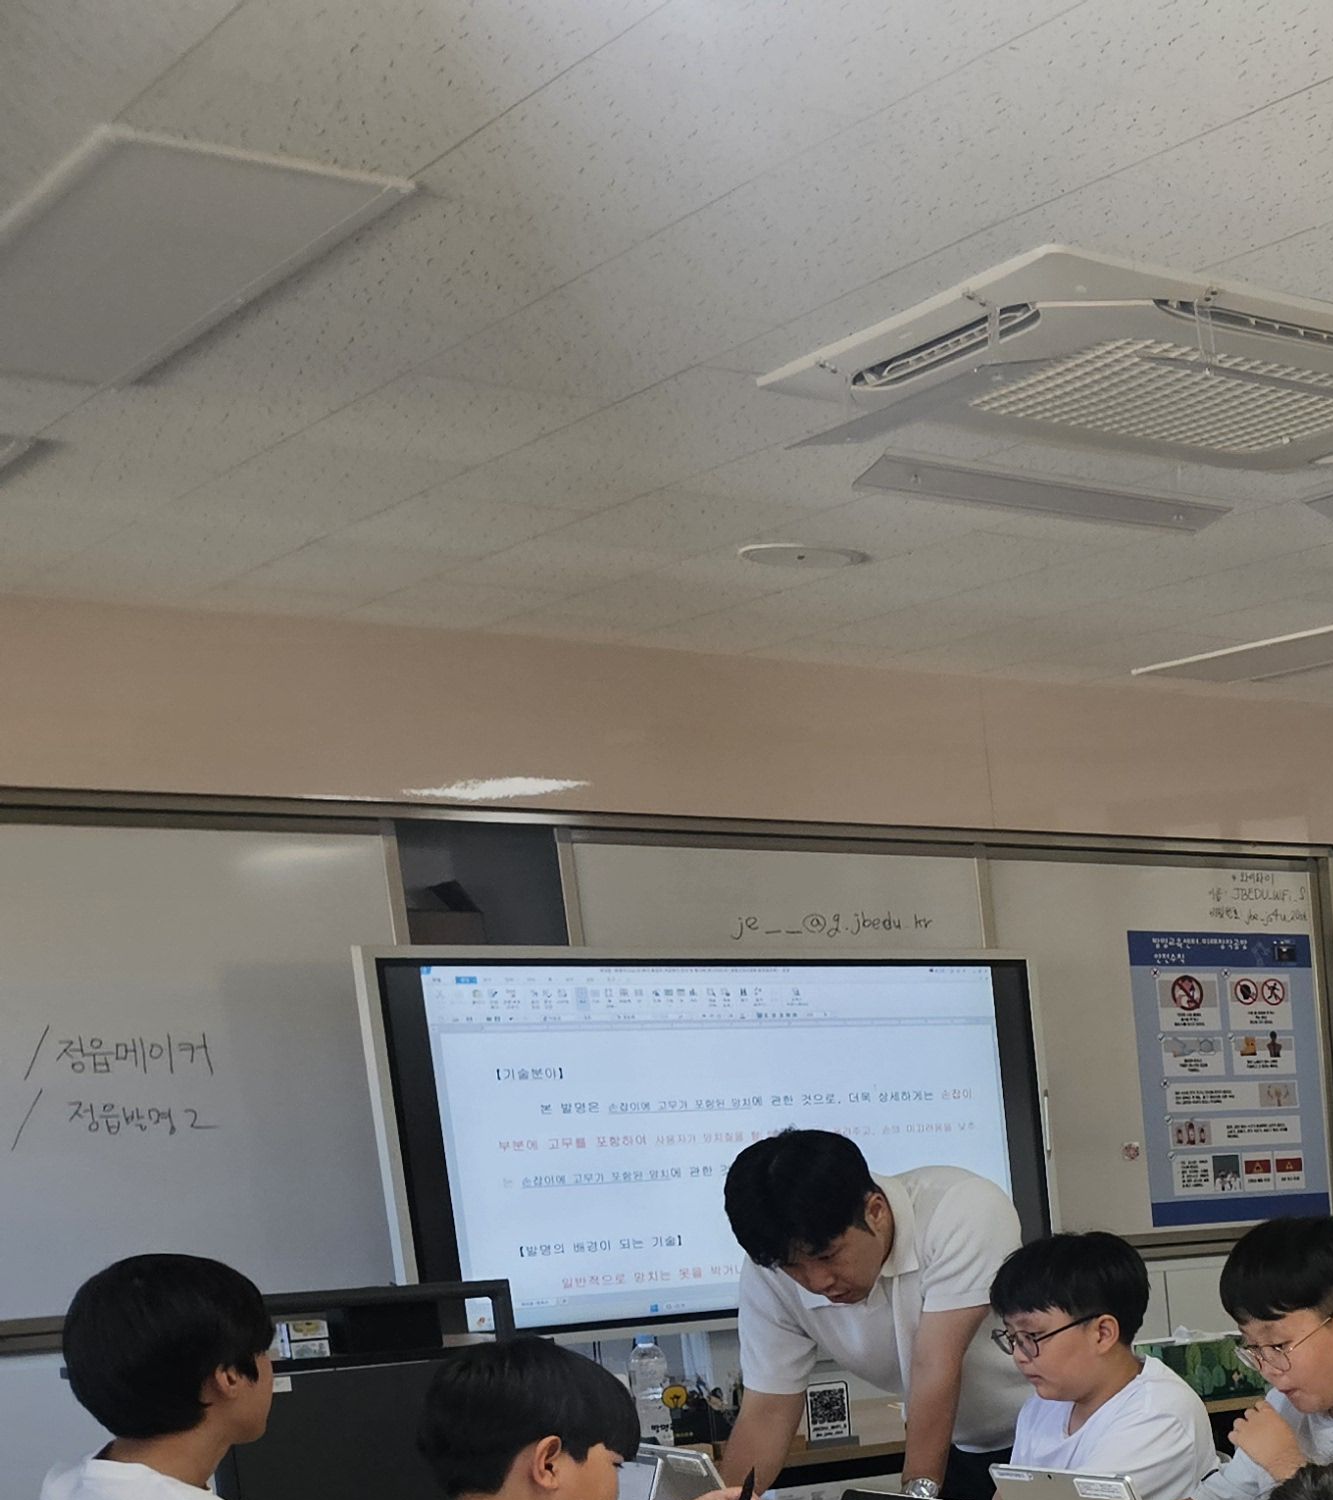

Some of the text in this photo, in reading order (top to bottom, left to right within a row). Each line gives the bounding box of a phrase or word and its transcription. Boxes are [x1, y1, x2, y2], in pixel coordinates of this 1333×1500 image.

[56, 1032, 214, 1076] 정읍메이커
[67, 1101, 177, 1136] 정읍발명
[561, 1101, 600, 1114] 발명은
[771, 1094, 793, 1107] 관한
[879, 1089, 933, 1103] 상세하게는
